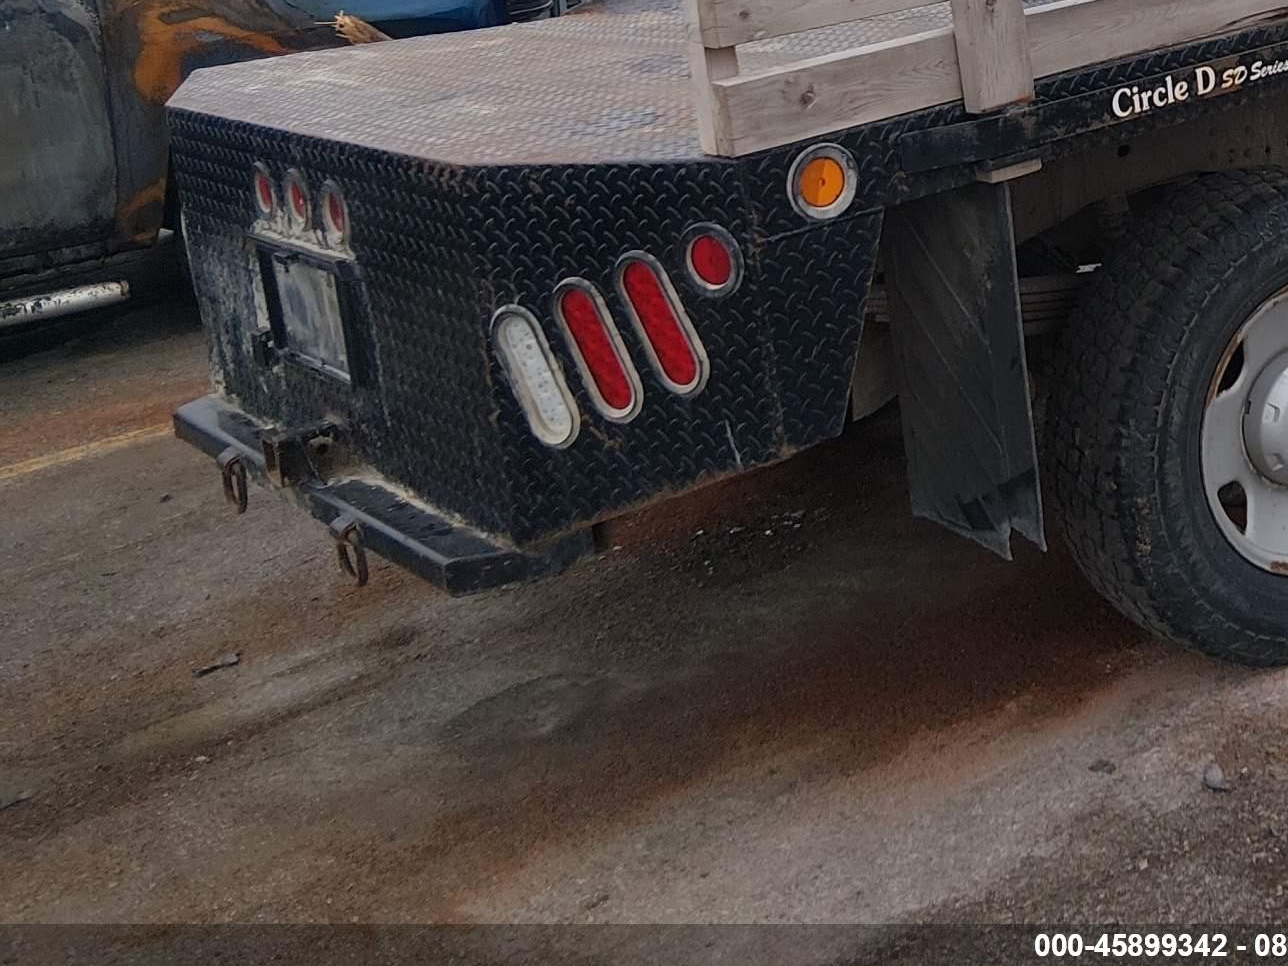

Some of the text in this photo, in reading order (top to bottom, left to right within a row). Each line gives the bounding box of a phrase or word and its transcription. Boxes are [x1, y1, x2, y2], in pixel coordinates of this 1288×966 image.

[1112, 76, 1189, 118] Circle
[1195, 66, 1216, 95] D
[1221, 65, 1248, 89] SD
